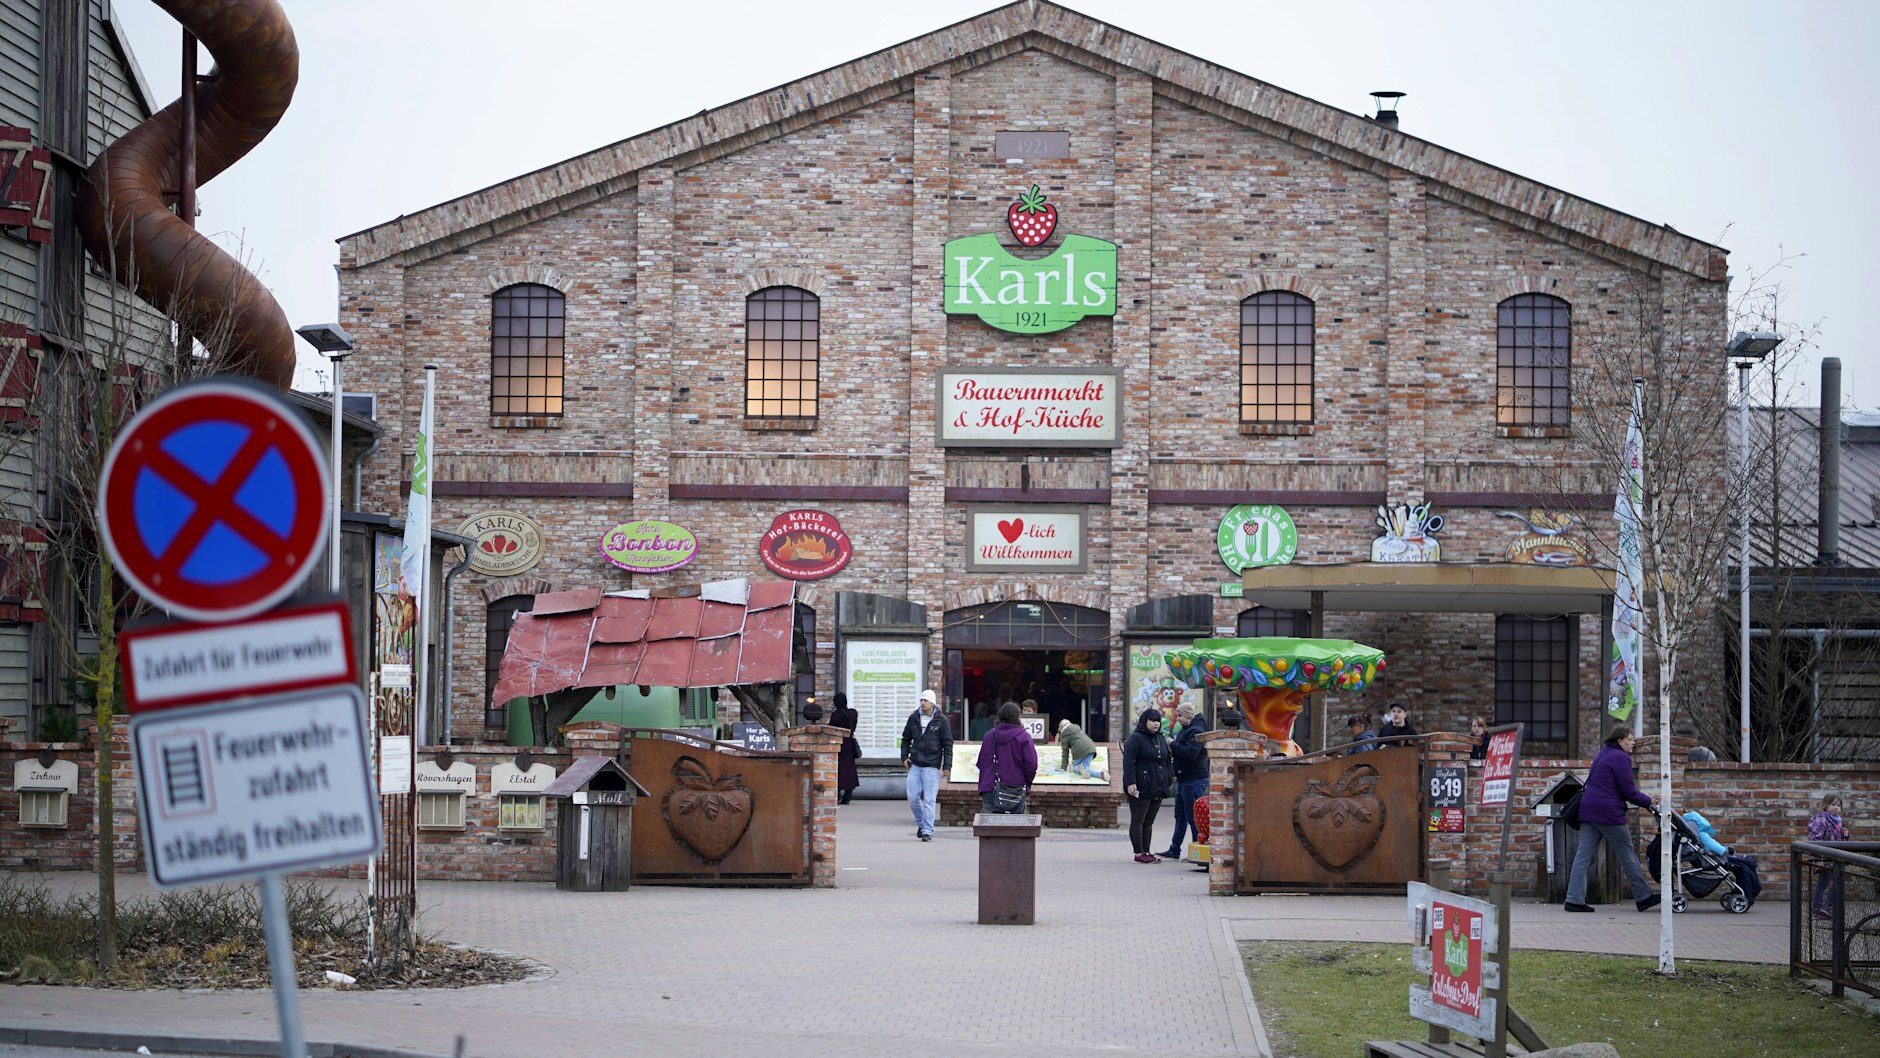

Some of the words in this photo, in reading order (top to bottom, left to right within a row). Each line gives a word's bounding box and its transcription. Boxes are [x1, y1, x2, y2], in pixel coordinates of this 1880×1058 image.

[1017, 138, 1049, 153] 1921
[954, 253, 1108, 306] Karls
[1015, 312, 1047, 327] 1921
[953, 379, 1105, 402] Bauernmarkt
[953, 411, 969, 428] &
[976, 406, 1105, 435] Hof-Küche
[475, 517, 525, 532] KARLS
[789, 512, 824, 521] KARLS
[1224, 504, 1289, 530] Fredas
[768, 521, 843, 540] Hof-Bäckerei
[606, 531, 693, 552] Bonbon
[979, 544, 1074, 560] Willkommen
[143, 655, 206, 681] Zufahrt
[209, 650, 236, 670] für
[241, 637, 333, 666] Feuerwehr
[1132, 656, 1160, 667] Karls
[213, 721, 349, 762] Feuerwehr-
[748, 734, 771, 743] Karls
[30, 771, 61, 781] Zirkow
[248, 763, 330, 800] zufahrt
[416, 773, 473, 785] Rövershagen
[509, 775, 537, 785] Elstal
[1435, 768, 1458, 779] Täglich
[1434, 797, 1458, 807] geöffnet
[163, 822, 249, 866] ständig
[253, 813, 366, 847] freihalten
[1445, 938, 1468, 967] Karls
[1432, 971, 1482, 1016] Erlebnis-Dorf
